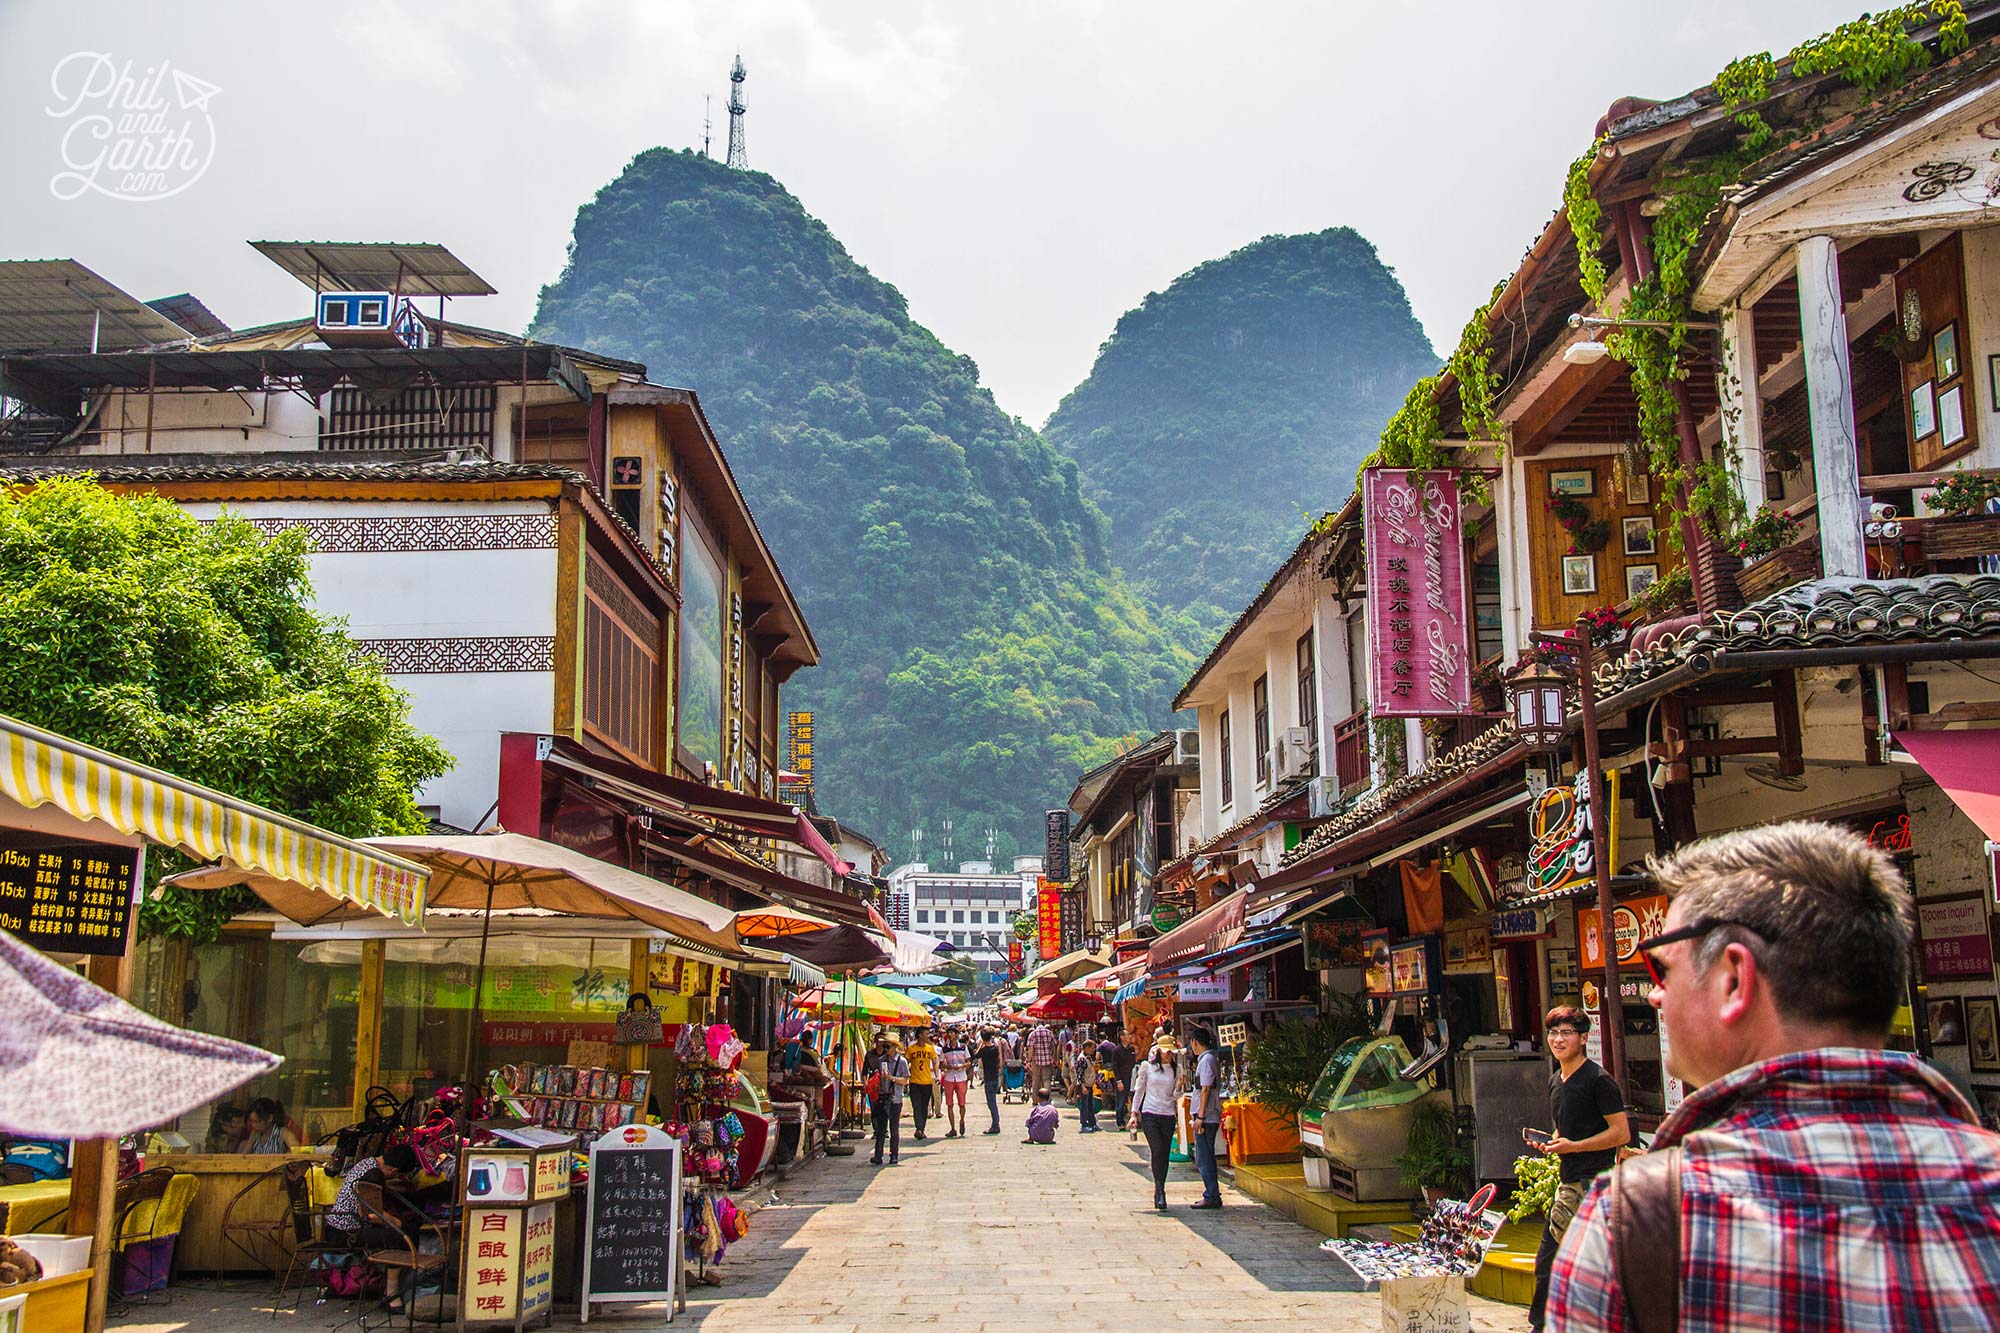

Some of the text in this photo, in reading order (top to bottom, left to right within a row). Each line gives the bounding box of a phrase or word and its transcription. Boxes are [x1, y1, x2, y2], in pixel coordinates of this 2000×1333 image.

[1387, 556, 1412, 697] 玫瑰木酒店餐厅
[1427, 618, 1462, 713] Hotel
[1573, 767, 1596, 874] 猪扒包
[38, 854, 63, 869] 芒果汁
[72, 859, 82, 870] 15
[87, 860, 110, 875] 香橙汁
[120, 865, 129, 876] 15
[1496, 860, 1523, 882] Italian
[36, 870, 127, 891] 西瓜汁 15 哈密瓜汁 15
[33, 886, 59, 902] 菠萝汁
[68, 891, 77, 902] 15
[83, 892, 113, 907] 火龙果汁
[116, 896, 125, 907] 18
[1495, 884, 1505, 899] ice
[66, 907, 75, 918] 15
[81, 907, 111, 922] 奇异果汁
[114, 912, 123, 922] 18
[63, 923, 73, 934] 10
[112, 927, 121, 938] 15
[1627, 928, 1638, 936] bun
[911, 1051, 931, 1059] CAVS
[919, 1060, 924, 1071] 2
[476, 1213, 508, 1314] 自酿鲜啤
